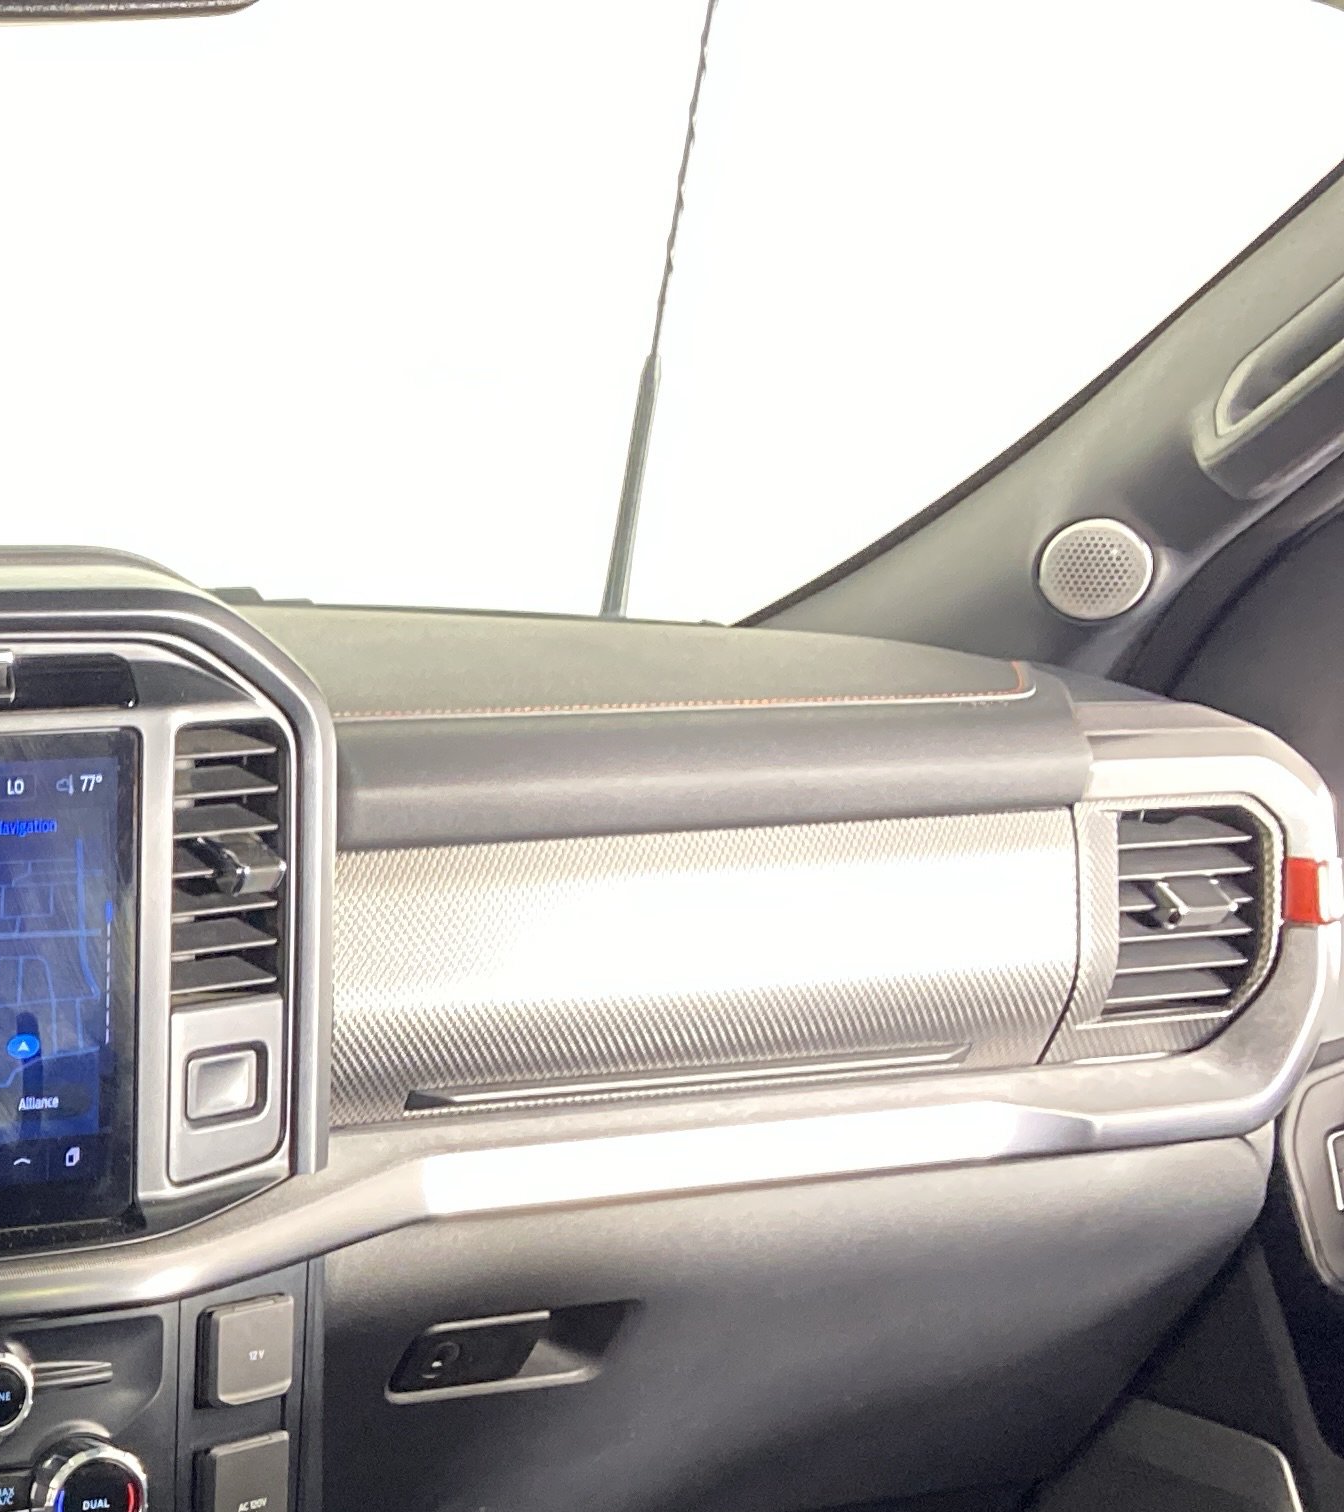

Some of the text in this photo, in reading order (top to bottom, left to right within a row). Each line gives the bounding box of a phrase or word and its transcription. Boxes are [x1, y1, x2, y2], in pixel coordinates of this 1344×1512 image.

[7, 779, 24, 795] LO
[18, 1096, 59, 1111] Alliance
[82, 1498, 111, 1511] DUAL
